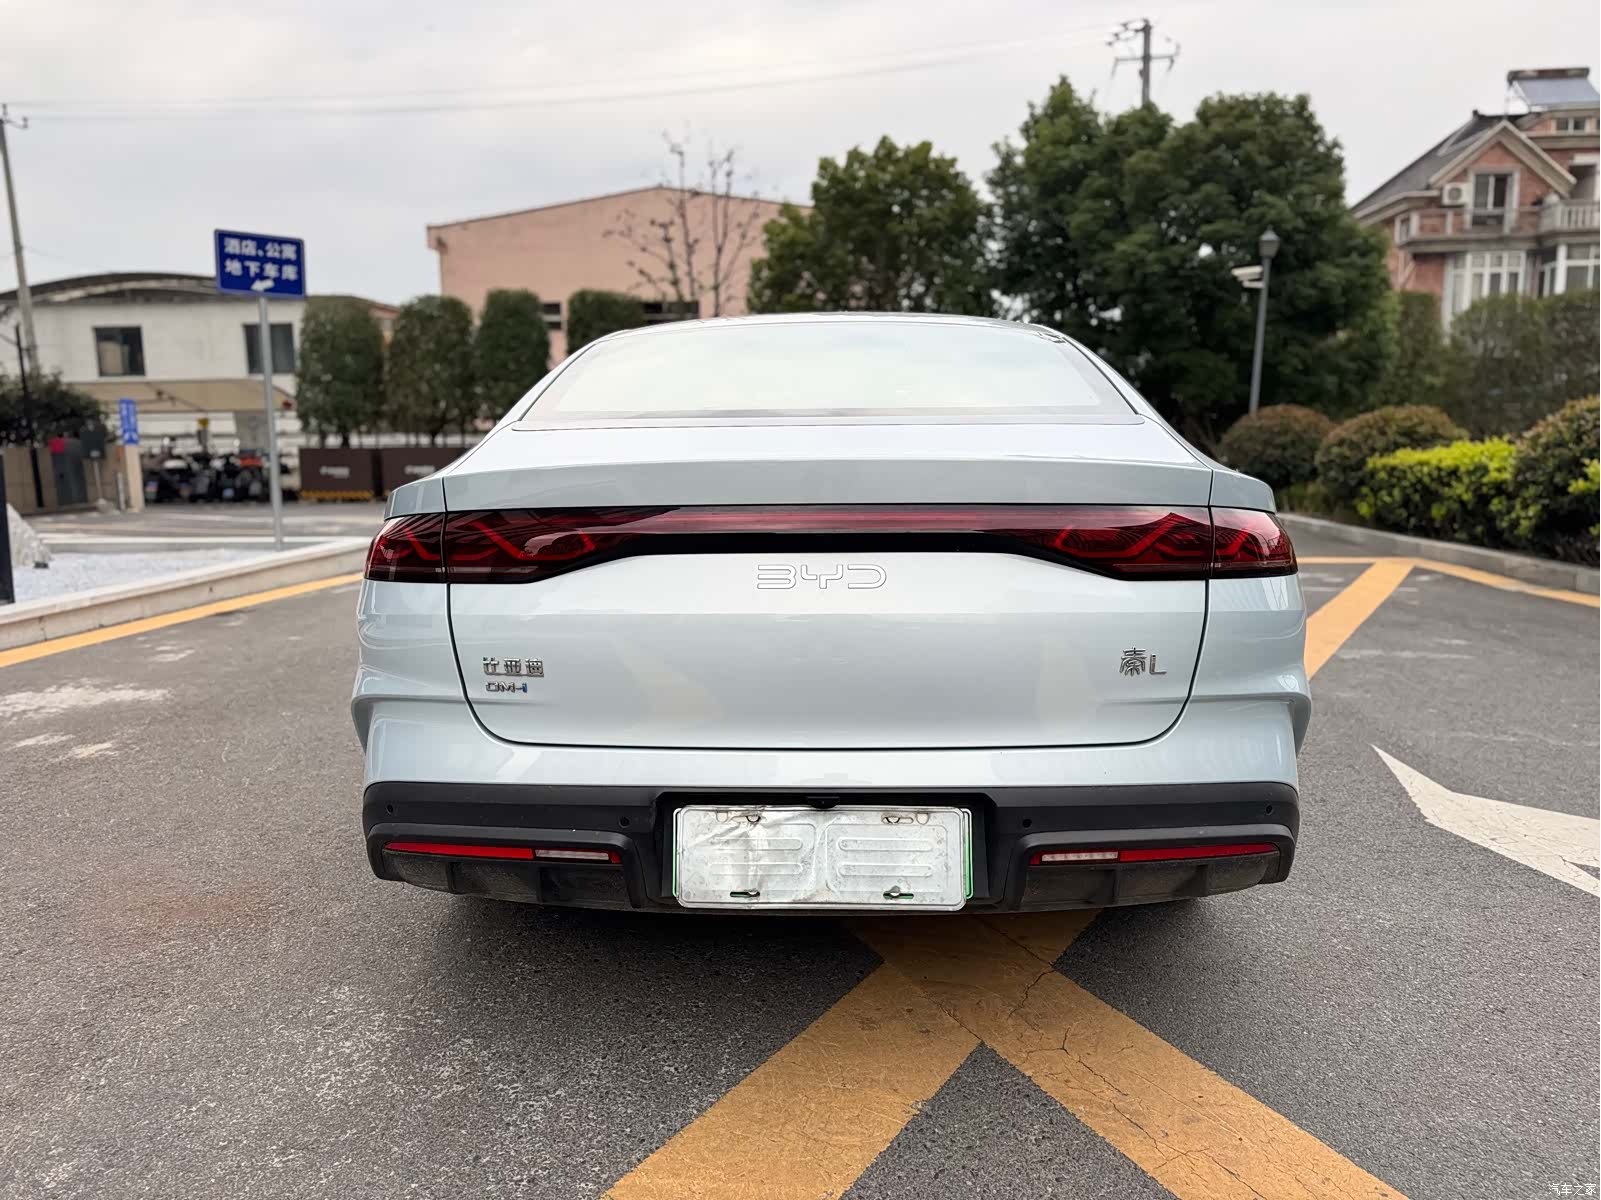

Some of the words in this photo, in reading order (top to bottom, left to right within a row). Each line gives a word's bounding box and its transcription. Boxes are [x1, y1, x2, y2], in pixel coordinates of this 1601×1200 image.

[224, 258, 299, 281] 地下车库
[757, 564, 887, 589] BYD
[482, 657, 544, 677] 比亚迪
